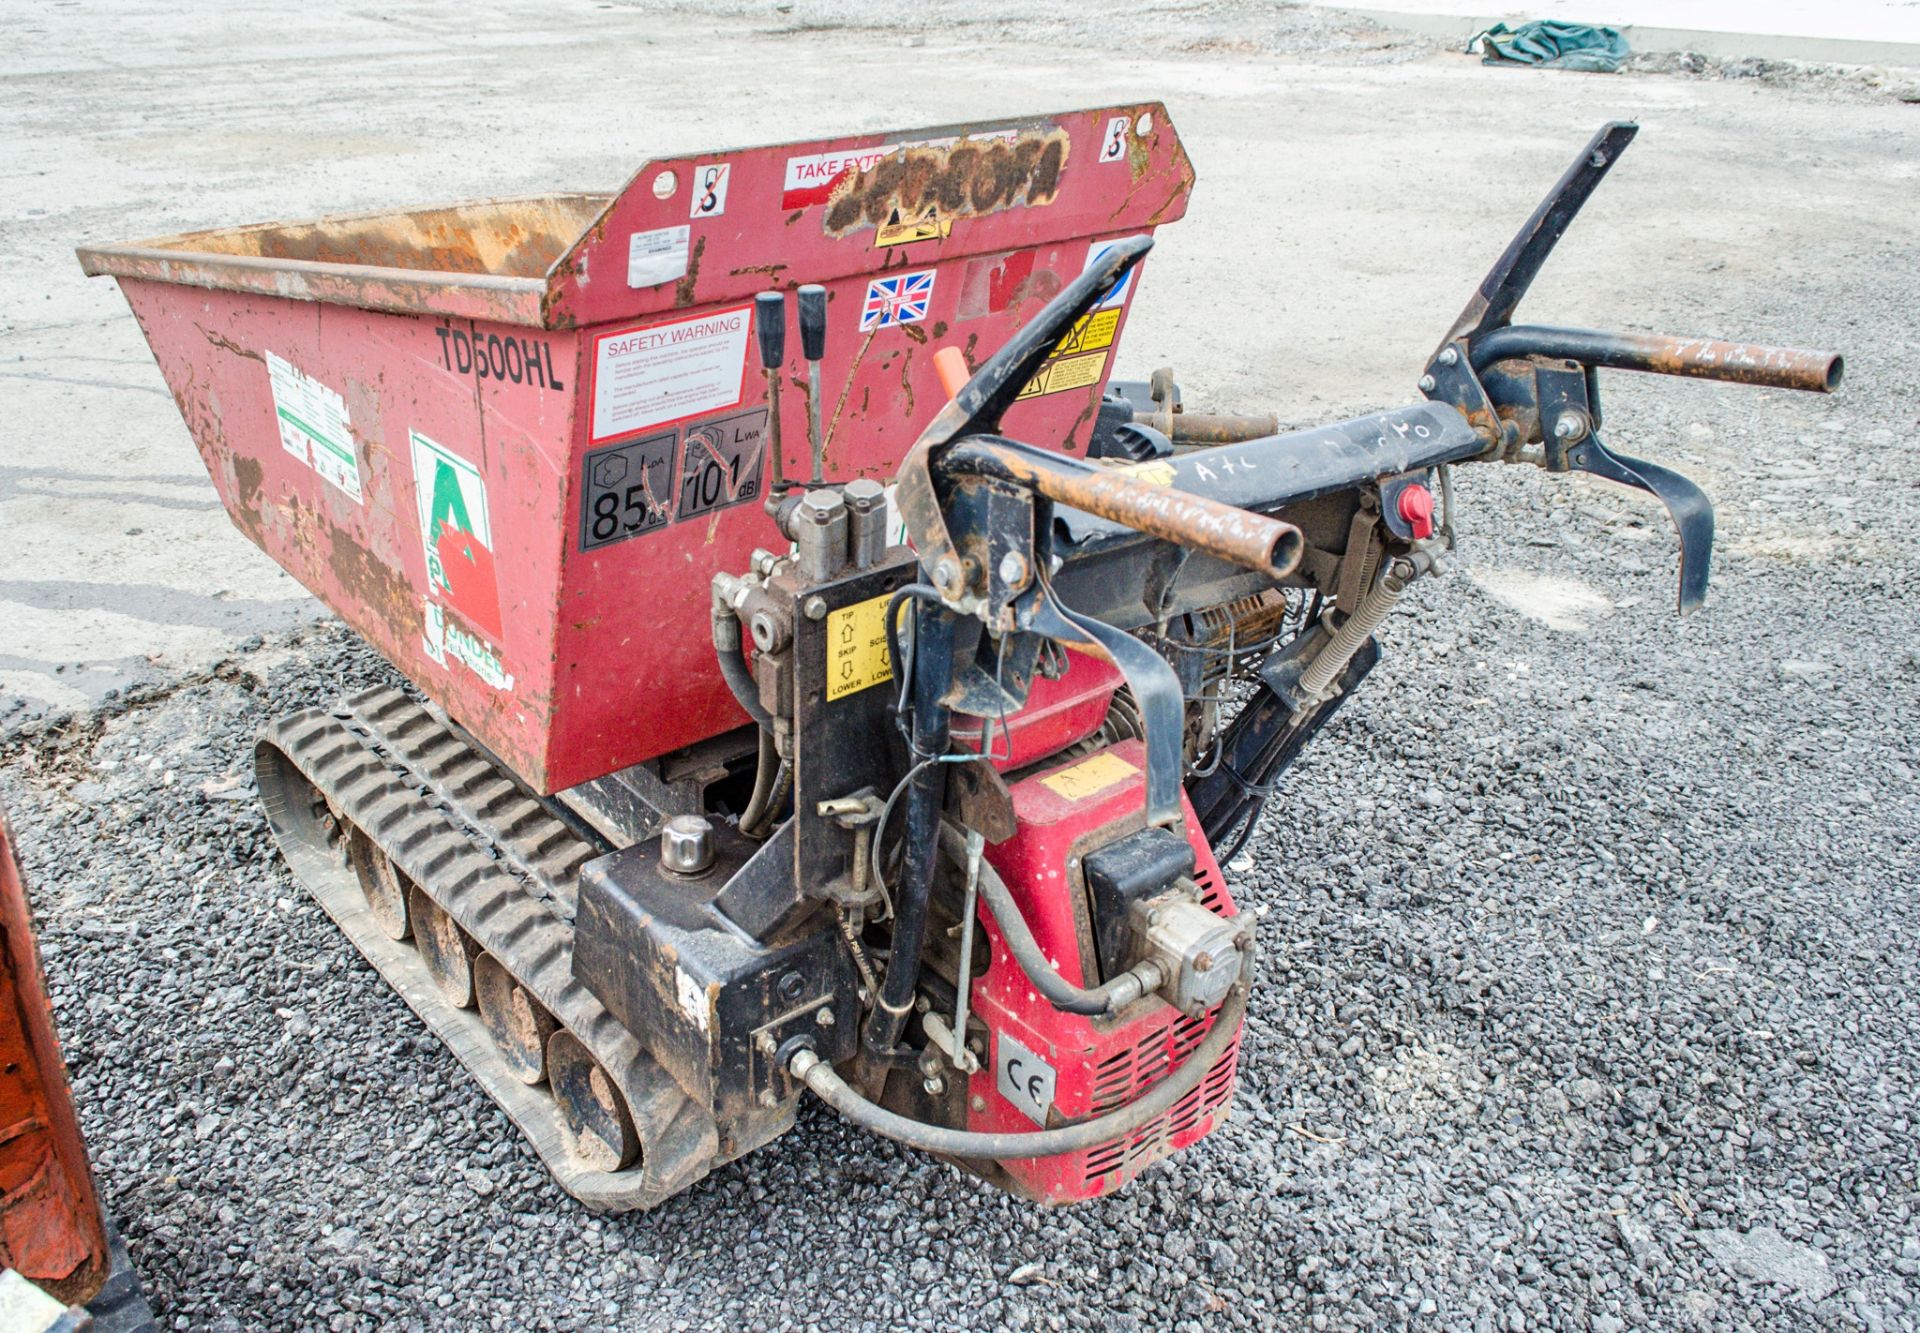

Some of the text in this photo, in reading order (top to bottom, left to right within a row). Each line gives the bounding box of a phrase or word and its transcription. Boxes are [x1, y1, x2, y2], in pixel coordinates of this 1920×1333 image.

[796, 160, 838, 180] TAKE
[608, 316, 741, 357] SAFETY WARNING
[435, 327, 564, 391] TD500HL
[686, 454, 755, 510] 101 dB
[592, 484, 647, 540] 85
[841, 611, 855, 621] TIP
[838, 645, 857, 658] SKIP
[832, 679, 863, 696] LOWER
[1007, 1058, 1044, 1109] CE
